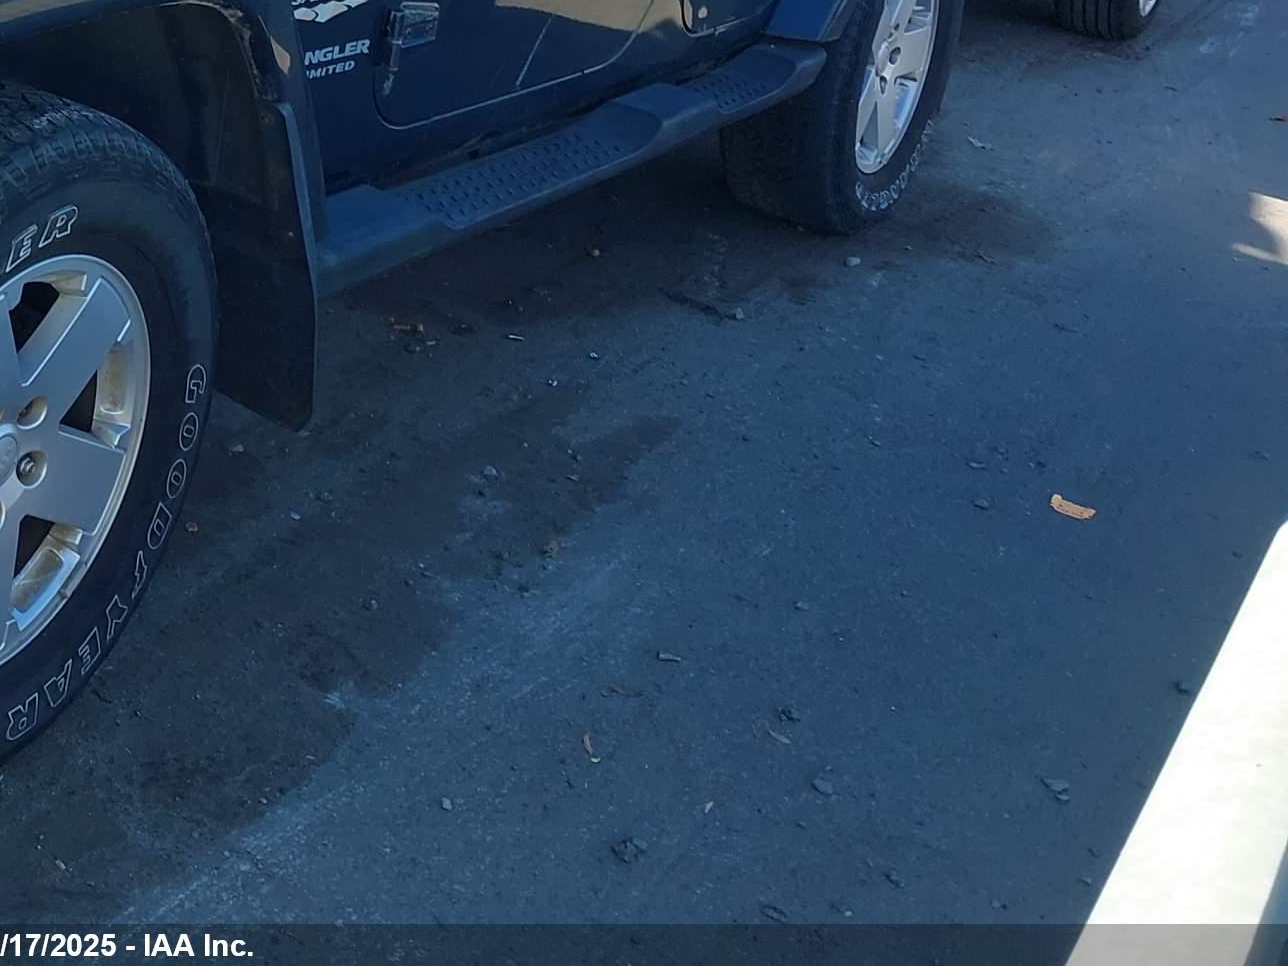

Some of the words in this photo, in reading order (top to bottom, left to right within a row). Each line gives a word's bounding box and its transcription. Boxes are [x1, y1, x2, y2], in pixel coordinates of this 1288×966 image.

[304, 38, 371, 66] NGLER
[306, 60, 355, 80] MITED
[5, 362, 208, 742] GOODYEAR
